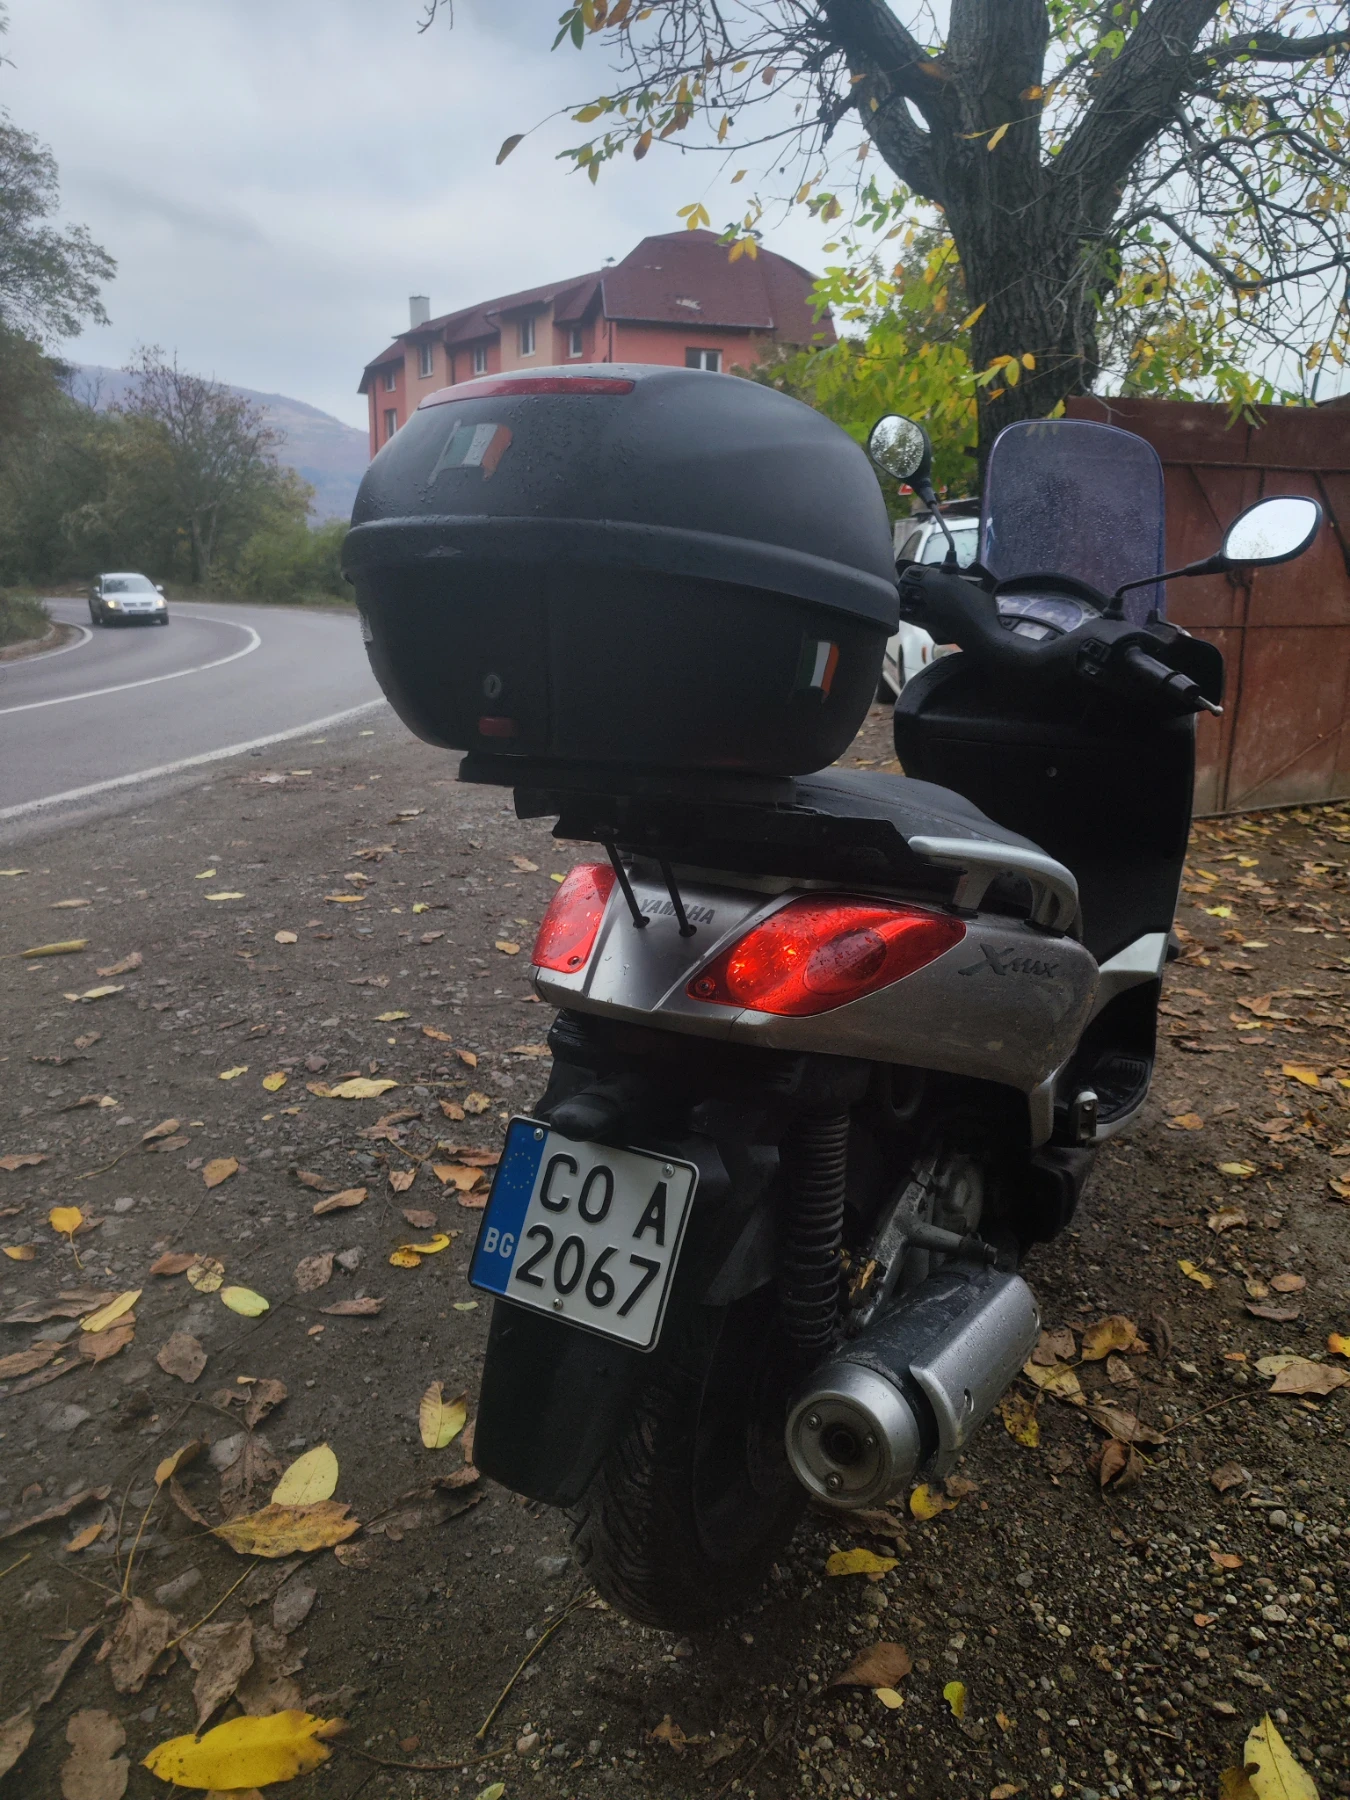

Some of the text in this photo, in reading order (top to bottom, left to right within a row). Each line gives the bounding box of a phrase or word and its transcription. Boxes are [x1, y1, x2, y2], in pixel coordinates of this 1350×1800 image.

[483, 1226, 516, 1259] BG
[539, 1152, 668, 1247] CO A
[514, 1223, 662, 1318] 2067
